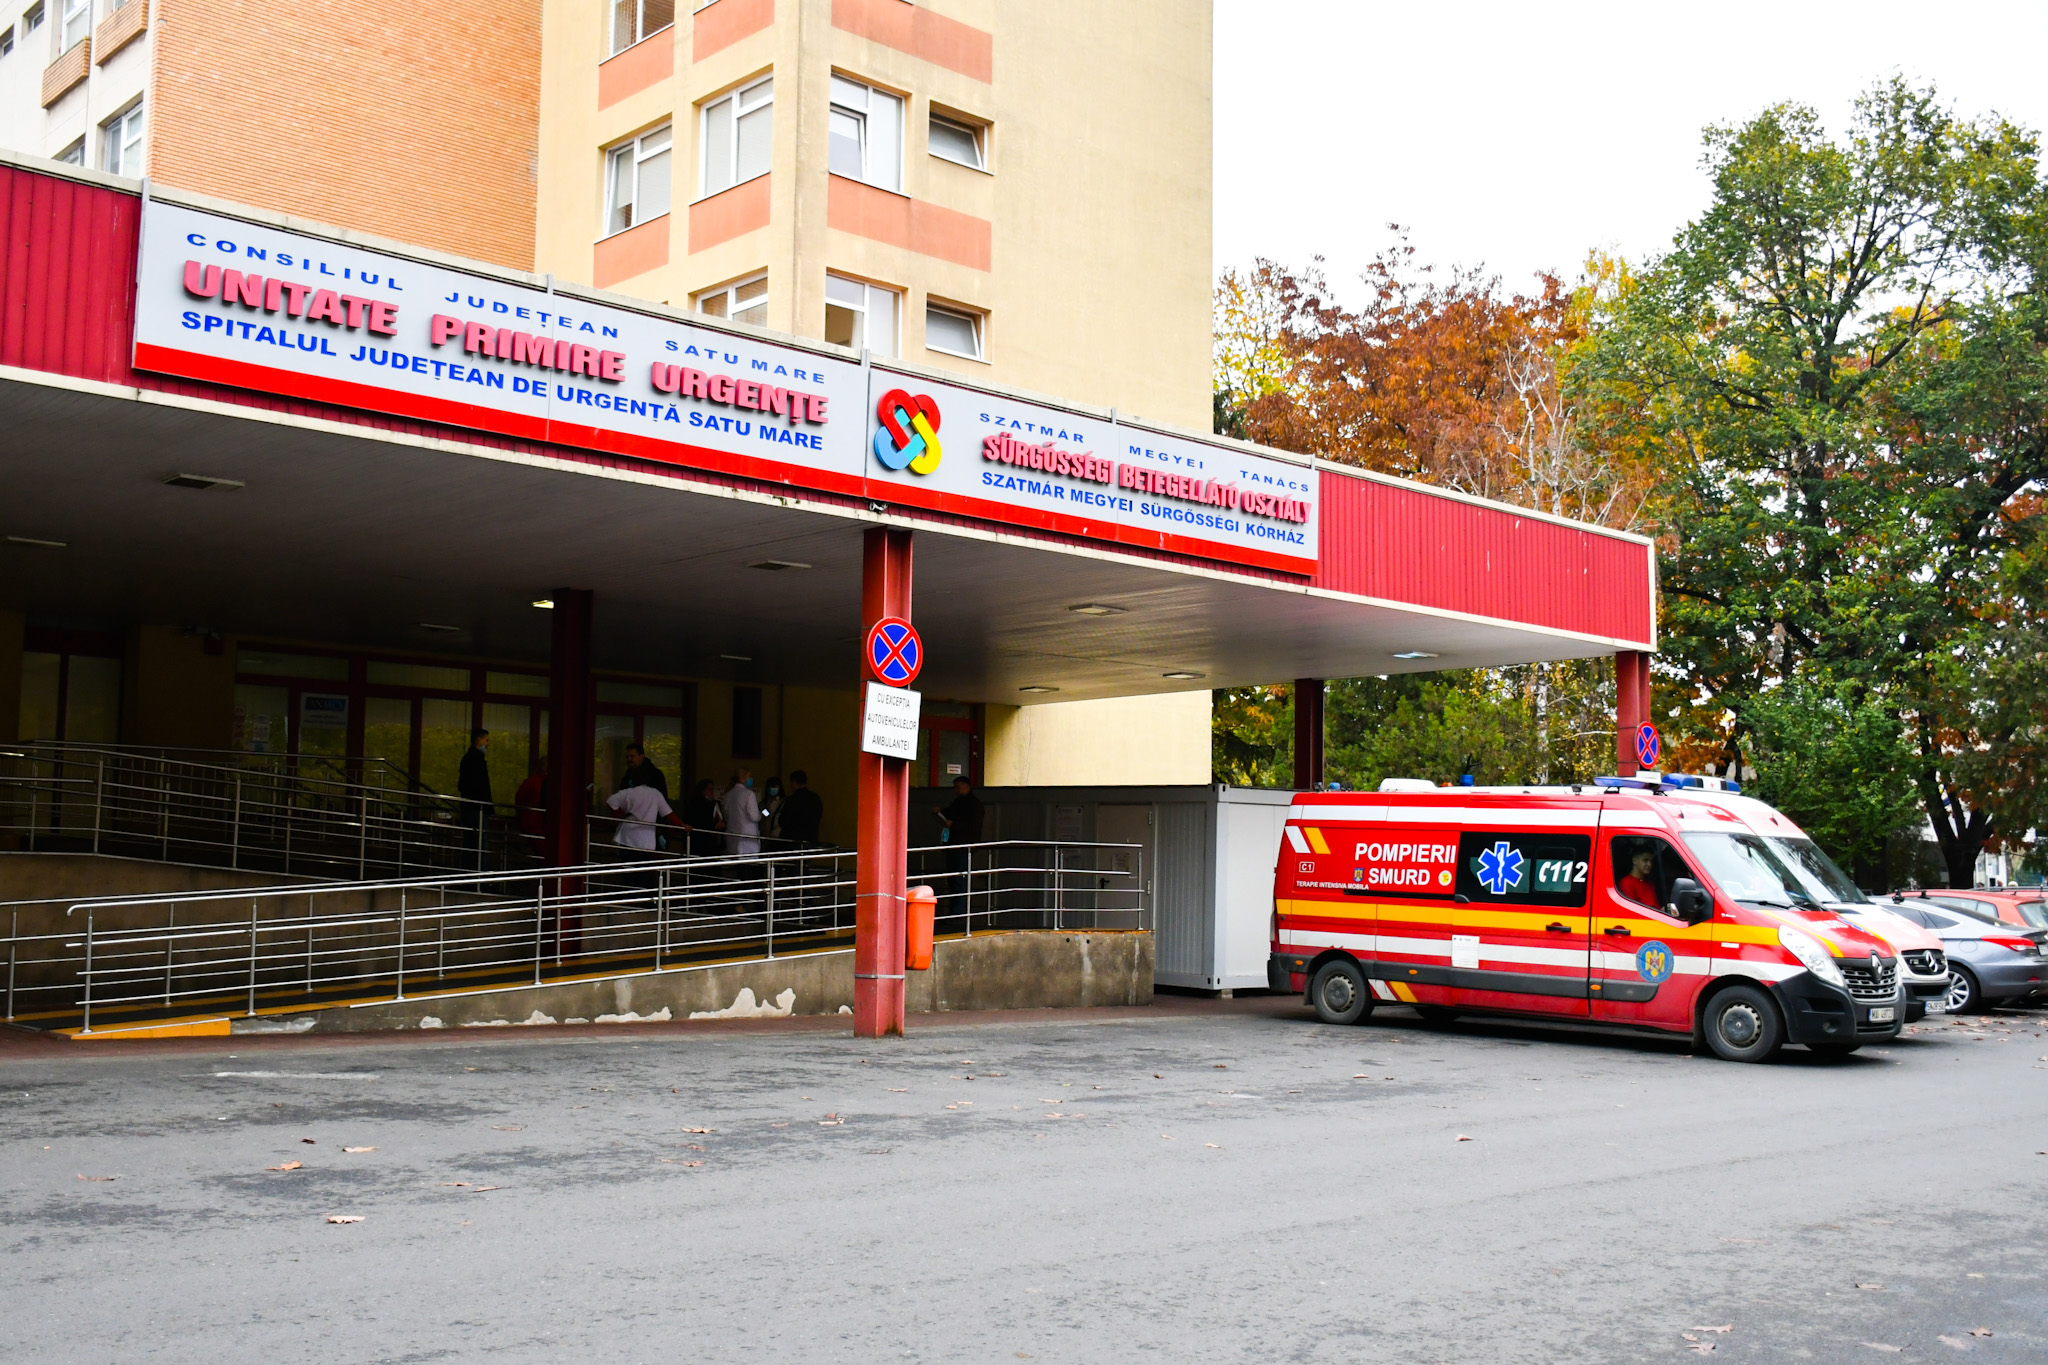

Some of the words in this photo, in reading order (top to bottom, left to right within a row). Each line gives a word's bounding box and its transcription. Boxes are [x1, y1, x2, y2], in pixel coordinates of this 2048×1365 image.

[187, 233, 403, 291] CONSILIUL
[445, 292, 618, 338] JUDEȚEAN
[665, 340, 739, 365] SATU
[751, 359, 825, 384] MARE
[183, 260, 400, 336] UNITATE
[431, 313, 626, 383] PRIMIRE
[651, 361, 829, 424] URGENȚE
[182, 311, 337, 357] SPITALUL
[350, 345, 504, 389] JUDEȚEAN
[513, 373, 548, 397] DE
[557, 385, 680, 423] URGENȚĂ
[689, 411, 751, 436] SATU
[759, 425, 823, 450] MARE
[979, 413, 1084, 443] SZATMÁR
[1129, 445, 1203, 469] MEGYEI
[1240, 470, 1309, 492] TANÁCS
[1119, 463, 1240, 509] BETEGELLÁTÓ
[1241, 490, 1312, 524] OSZTÁLY
[982, 471, 1065, 499] SZATMÁR
[1070, 488, 1133, 513] MEGYEI
[1246, 523, 1305, 545] KÓRHÁZ
[877, 692, 885, 703] CU
[867, 713, 917, 730] AUTOVEHICULELOR
[1354, 843, 1457, 864] POMPIERII
[1301, 863, 1312, 871] C1
[1368, 867, 1431, 886] SMURD
[1550, 861, 1588, 883] 112
[1296, 880, 1319, 888] TERAPIE
[1320, 881, 1347, 889] INTENSIVA
